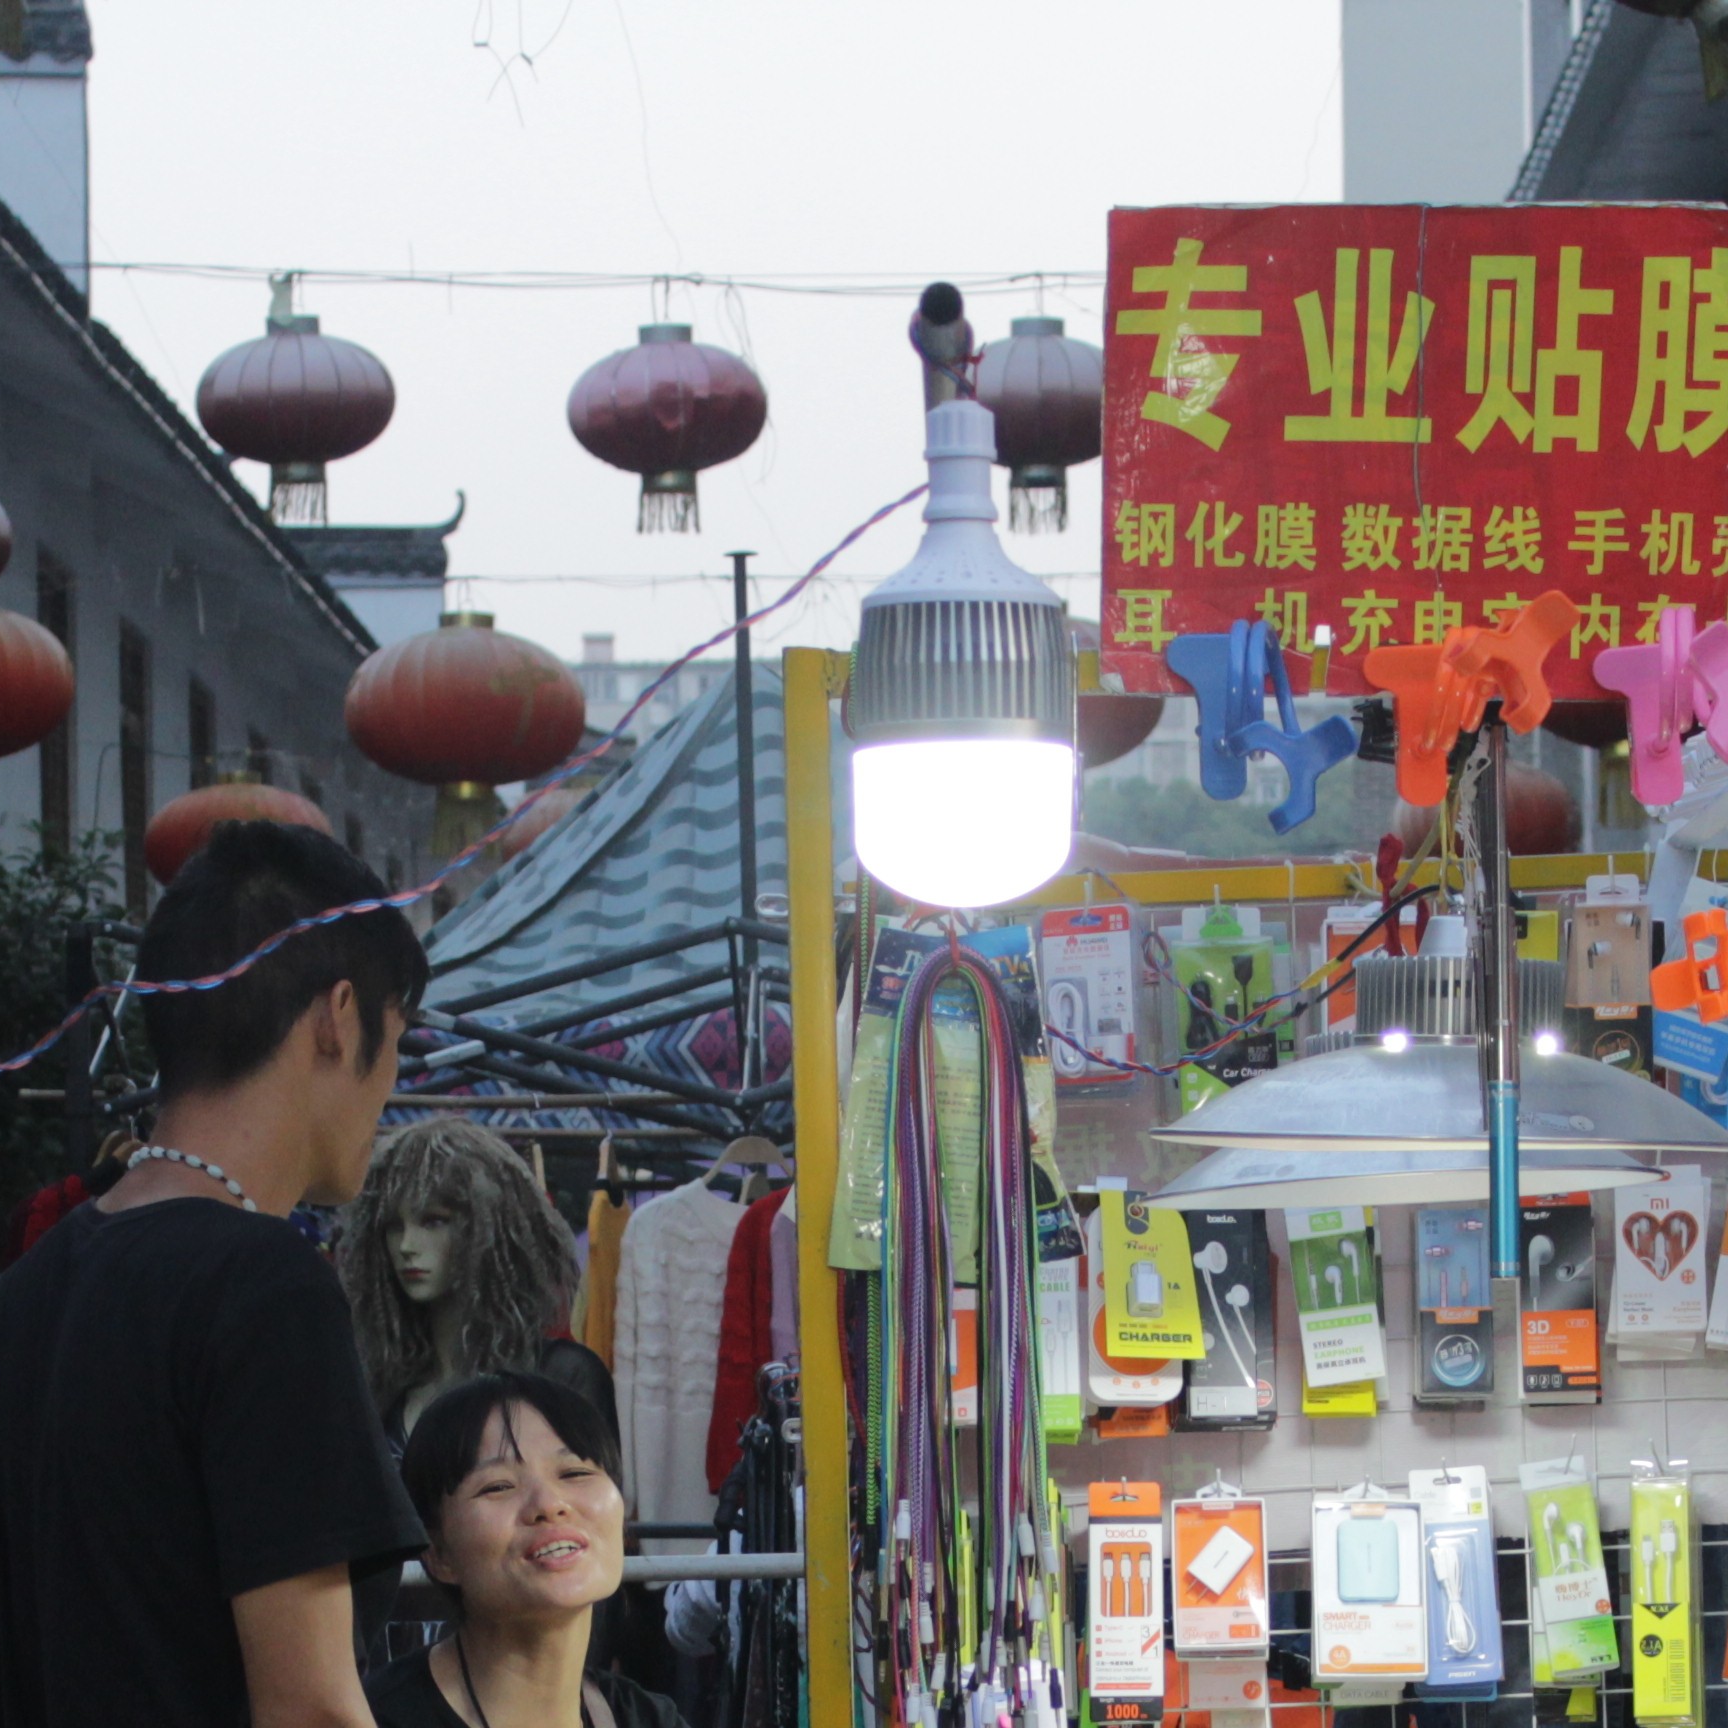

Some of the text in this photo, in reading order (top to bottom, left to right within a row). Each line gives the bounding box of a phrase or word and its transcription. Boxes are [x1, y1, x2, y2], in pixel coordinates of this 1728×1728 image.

[1115, 501, 1317, 571] 钢化膜
[1341, 503, 1545, 574] 数据线
[1222, 1067, 1273, 1079] Car Char
[1526, 1320, 1551, 1335] 3D
[1118, 1331, 1193, 1344] CHARGER
[1312, 1339, 1344, 1349] STEREO
[1313, 1346, 1365, 1360] EARPHONE
[1322, 1611, 1358, 1621] SMART
[1322, 1620, 1372, 1631] CHARGER
[1106, 1703, 1140, 1720] 1000
